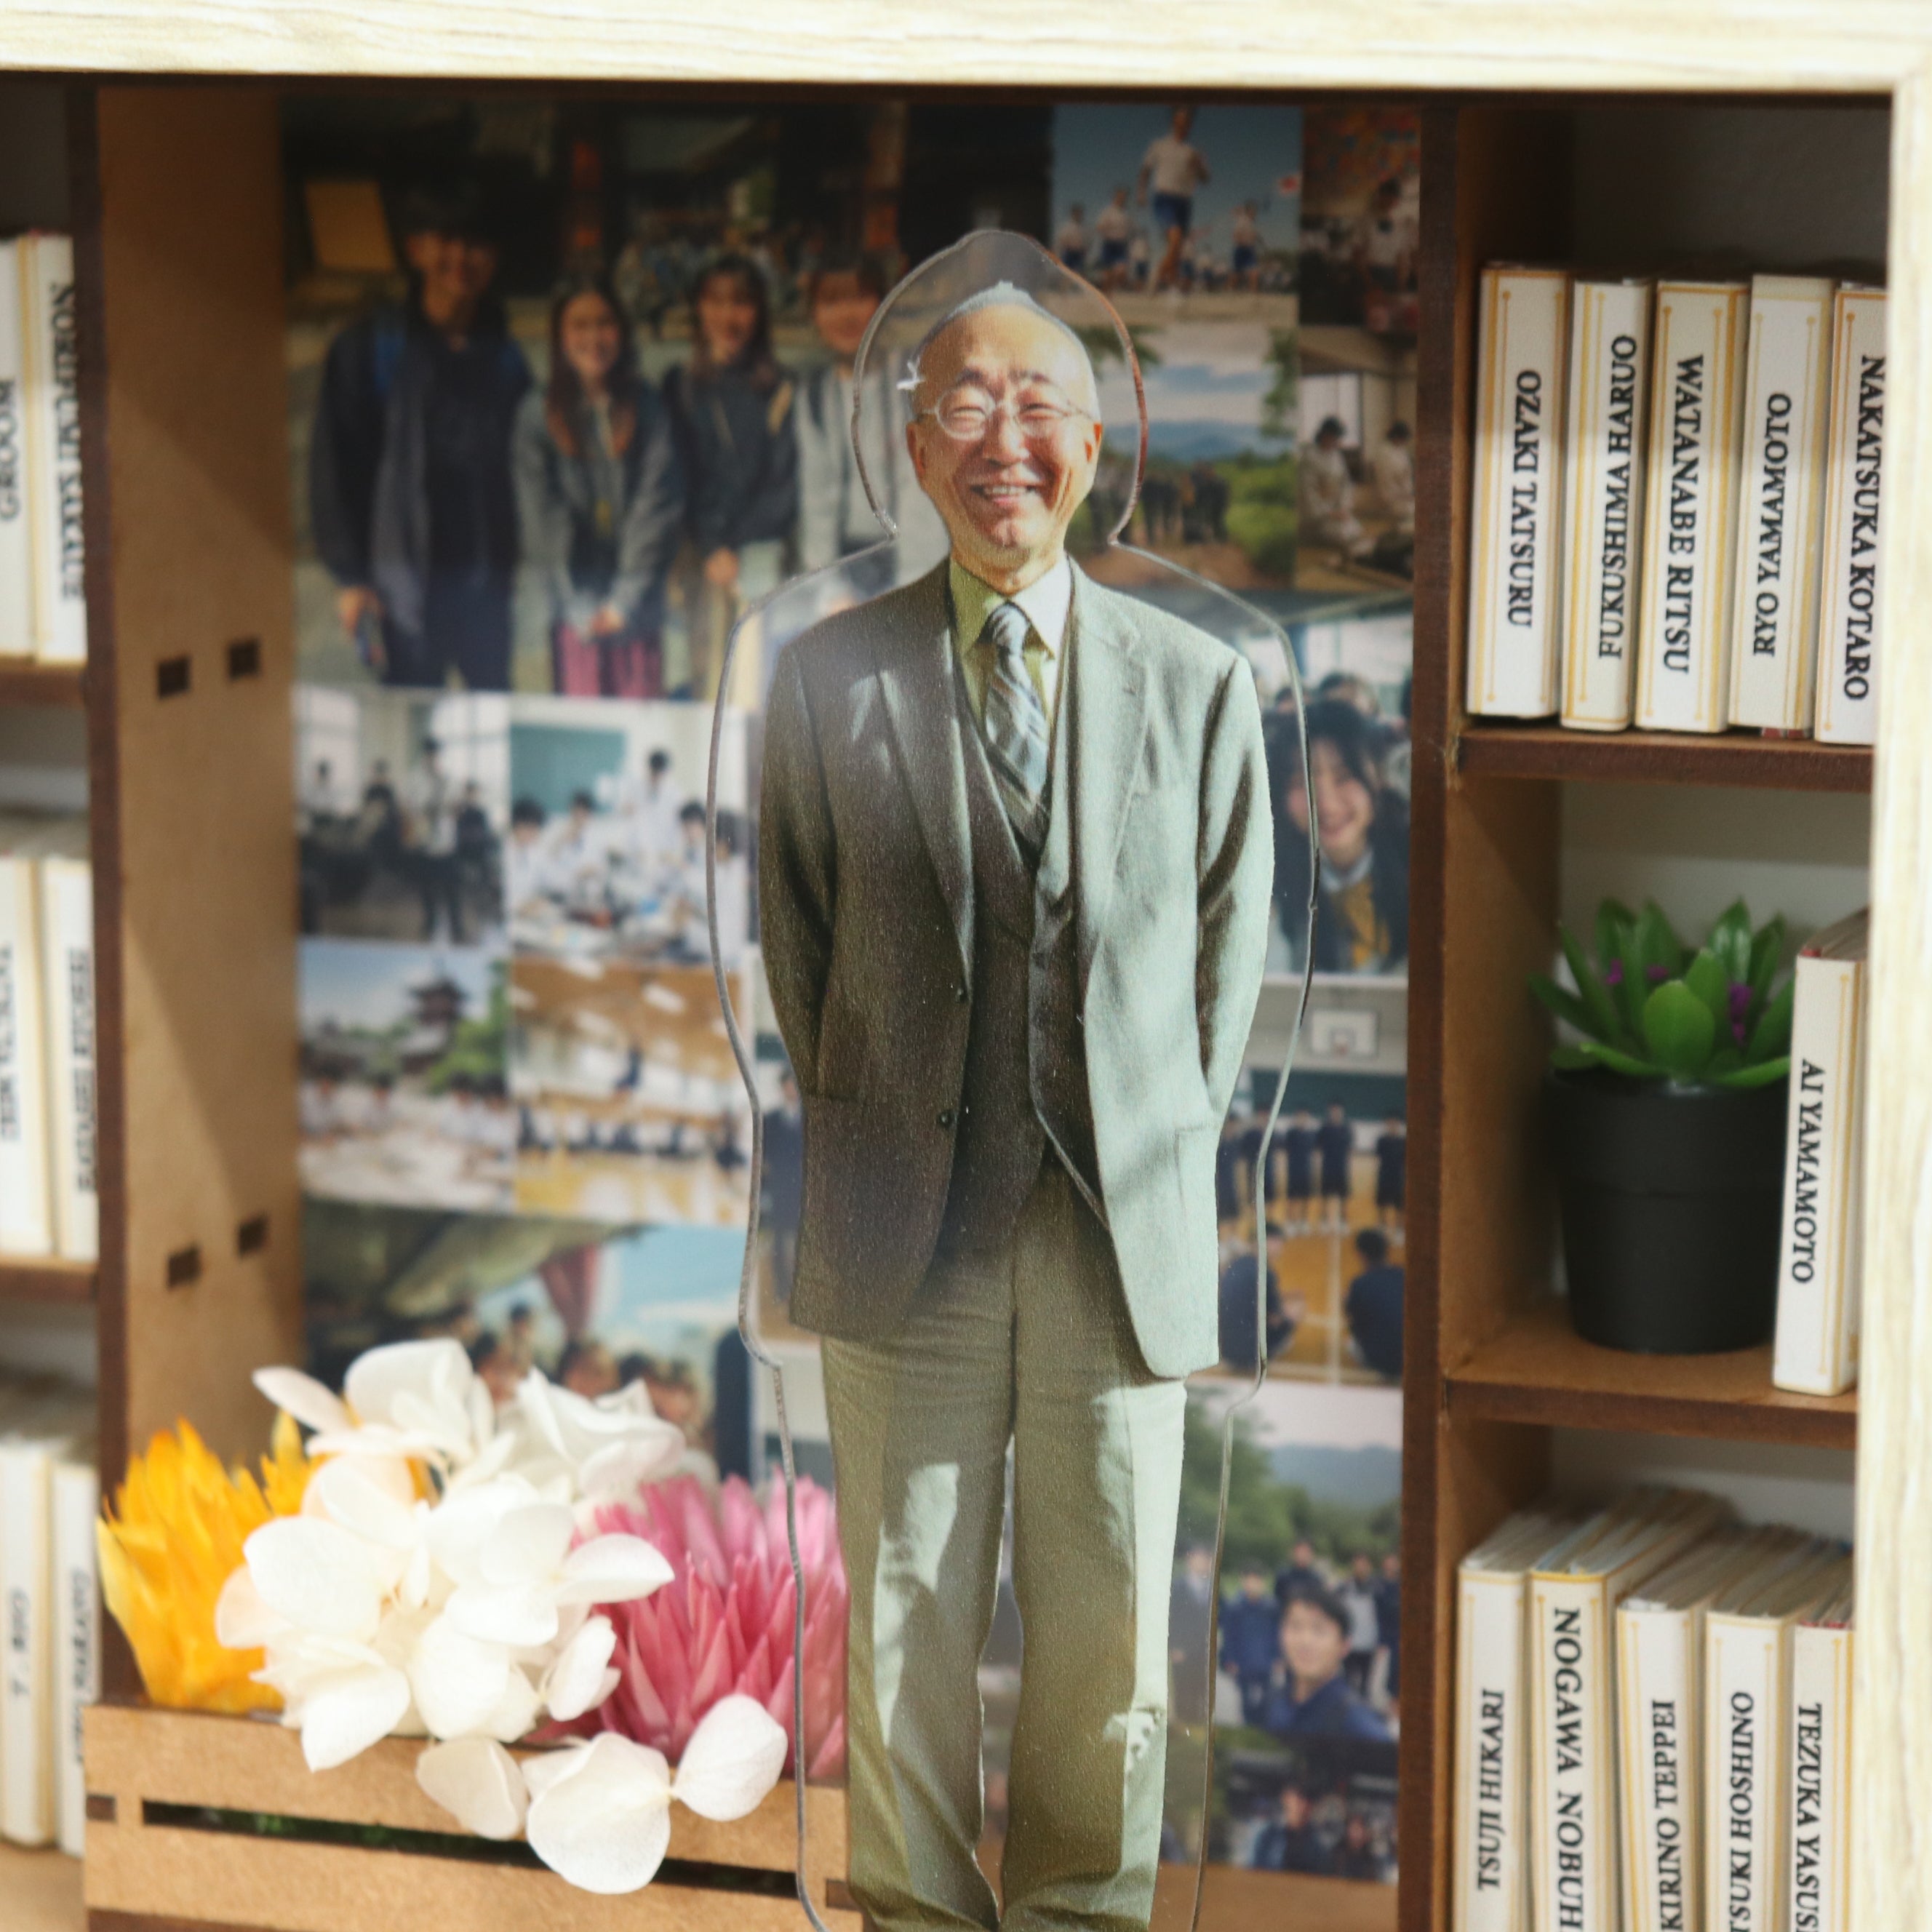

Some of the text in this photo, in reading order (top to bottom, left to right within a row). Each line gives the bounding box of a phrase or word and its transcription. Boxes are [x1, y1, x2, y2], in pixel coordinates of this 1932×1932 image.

[1507, 370, 1541, 628] OZAKI TATSURU
[1598, 335, 1637, 660] FUKUSHIMA HARUO
[1664, 354, 1704, 673] WATANABE RITSU
[1753, 392, 1792, 656] RYO YAMAMOTO
[1843, 354, 1885, 700] NAKATSUKA KOTARO
[1791, 1057, 1827, 1284] AI YAMAMOTO
[1477, 1689, 1505, 1890] TSUJI HIKARI
[1554, 1608, 1581, 1773] NOGAWA
[1730, 1692, 1753, 1840] HOSHINO
[1652, 1700, 1683, 1931] KIRINO TEPPEI
[1795, 1703, 1822, 1932] TEZUKA YASUS
